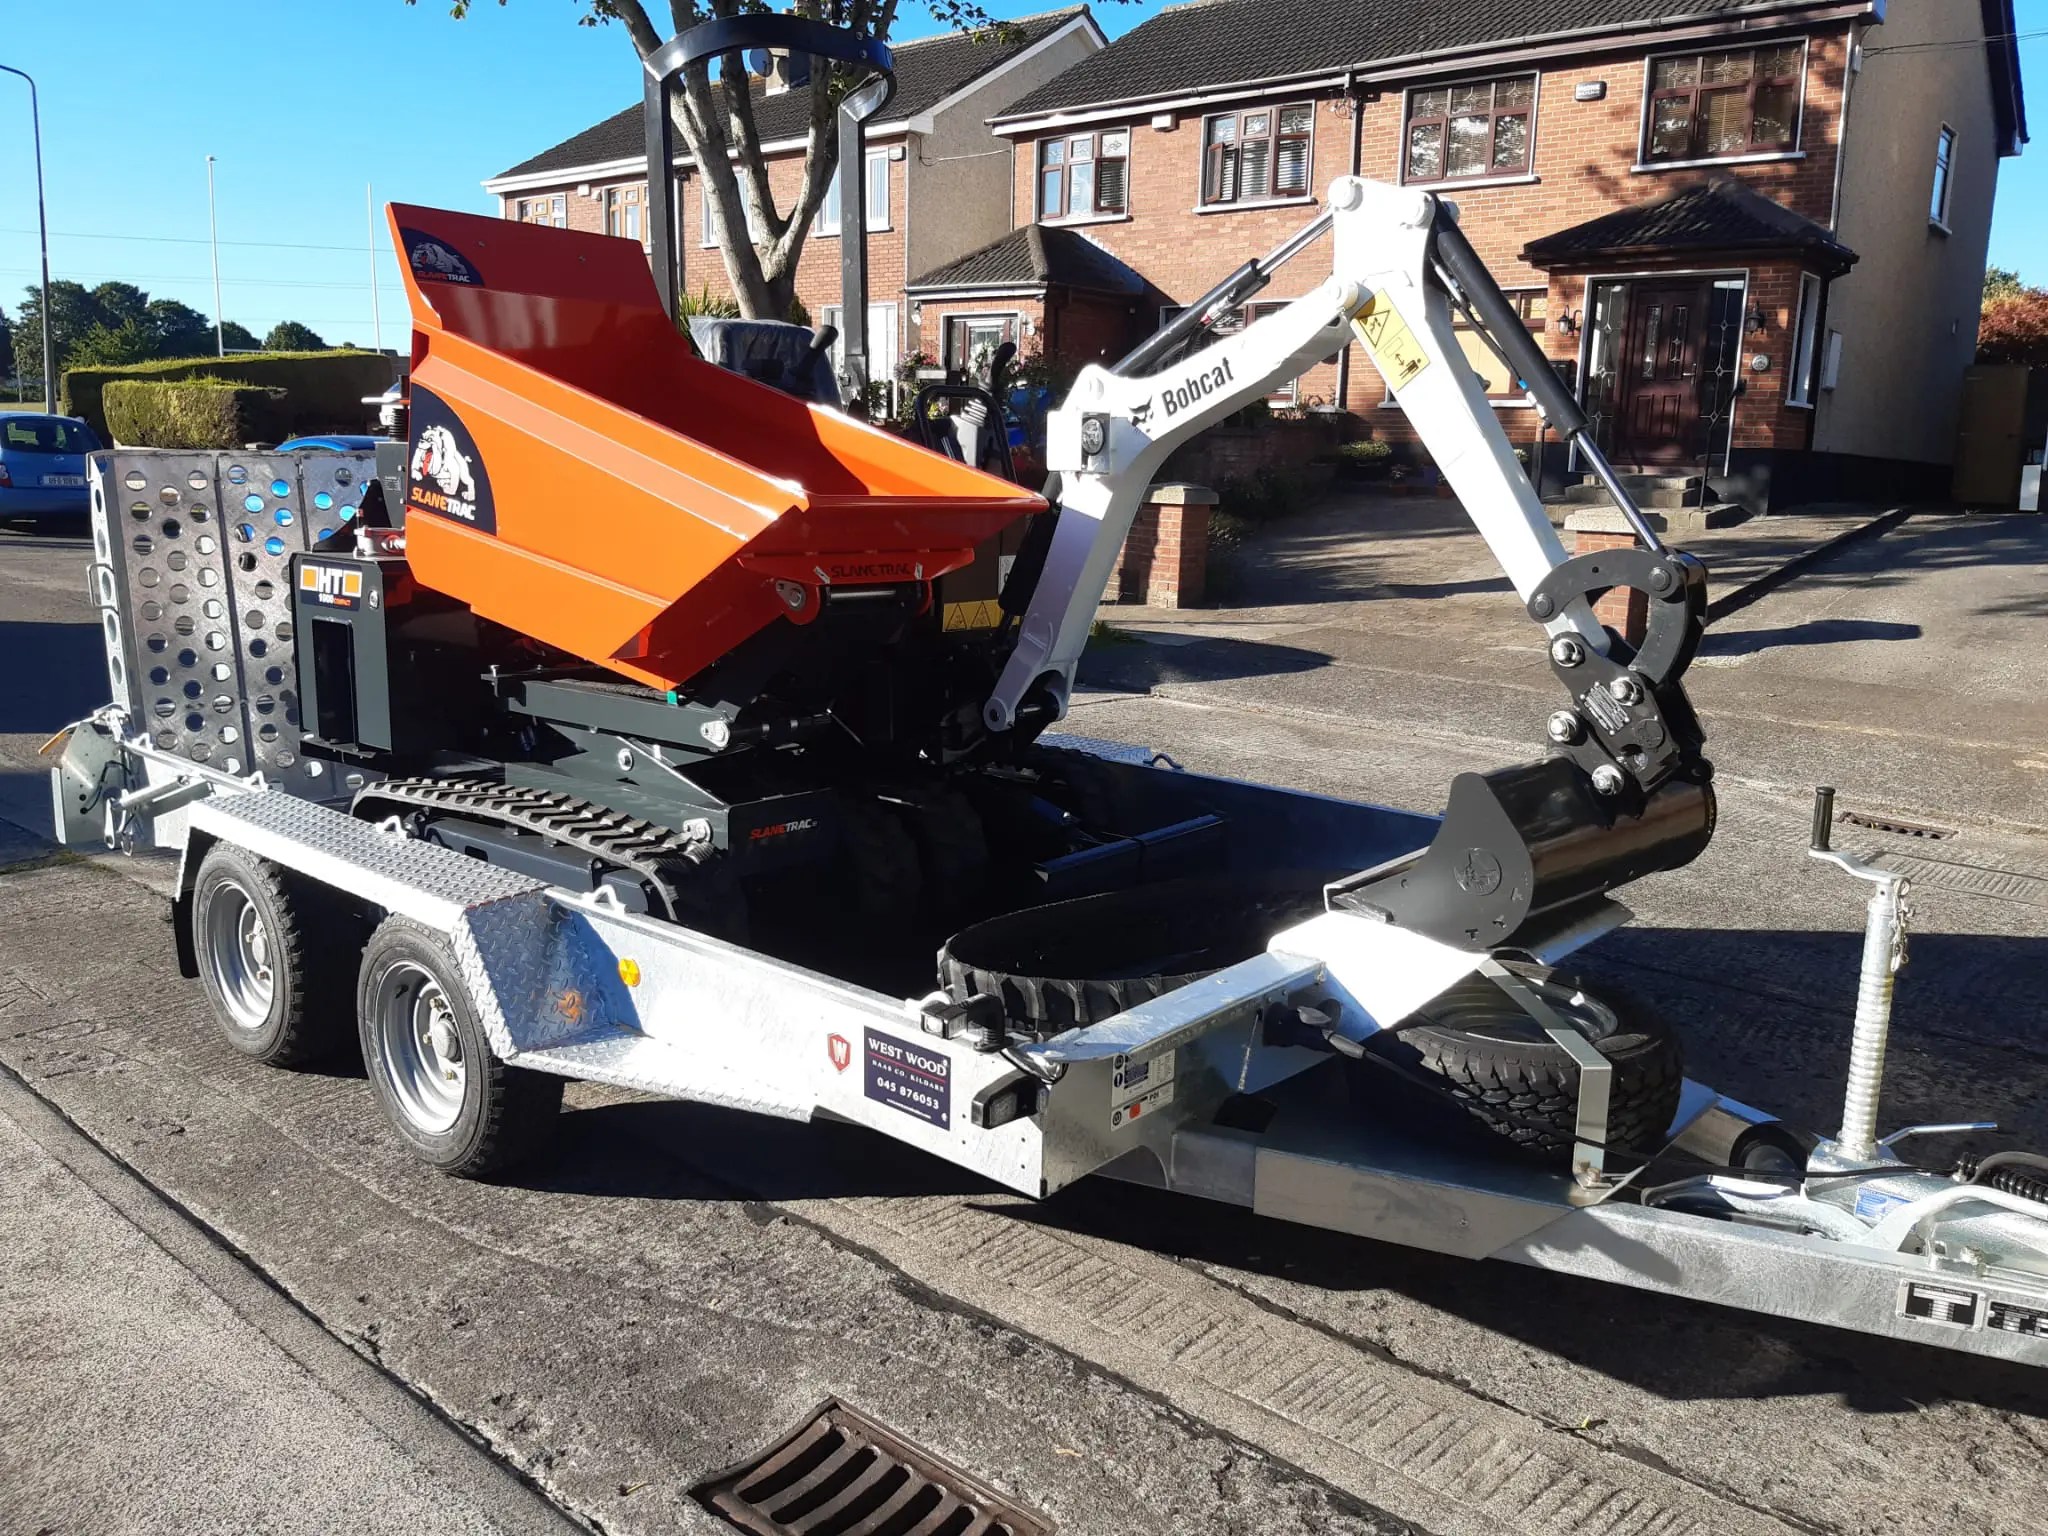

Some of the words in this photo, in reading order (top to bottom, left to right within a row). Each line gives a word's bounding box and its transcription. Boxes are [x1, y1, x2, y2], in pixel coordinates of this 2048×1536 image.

[1161, 357, 1234, 417] Bobcat
[411, 486, 476, 521] SLANETRAC
[751, 819, 812, 839] SLANETRAC
[868, 1038, 903, 1060] WEST
[905, 1051, 947, 1077] WOOD
[877, 1077, 897, 1092] 045
[899, 1086, 940, 1110] 876053
[910, 1074, 945, 1093] KILDARE
